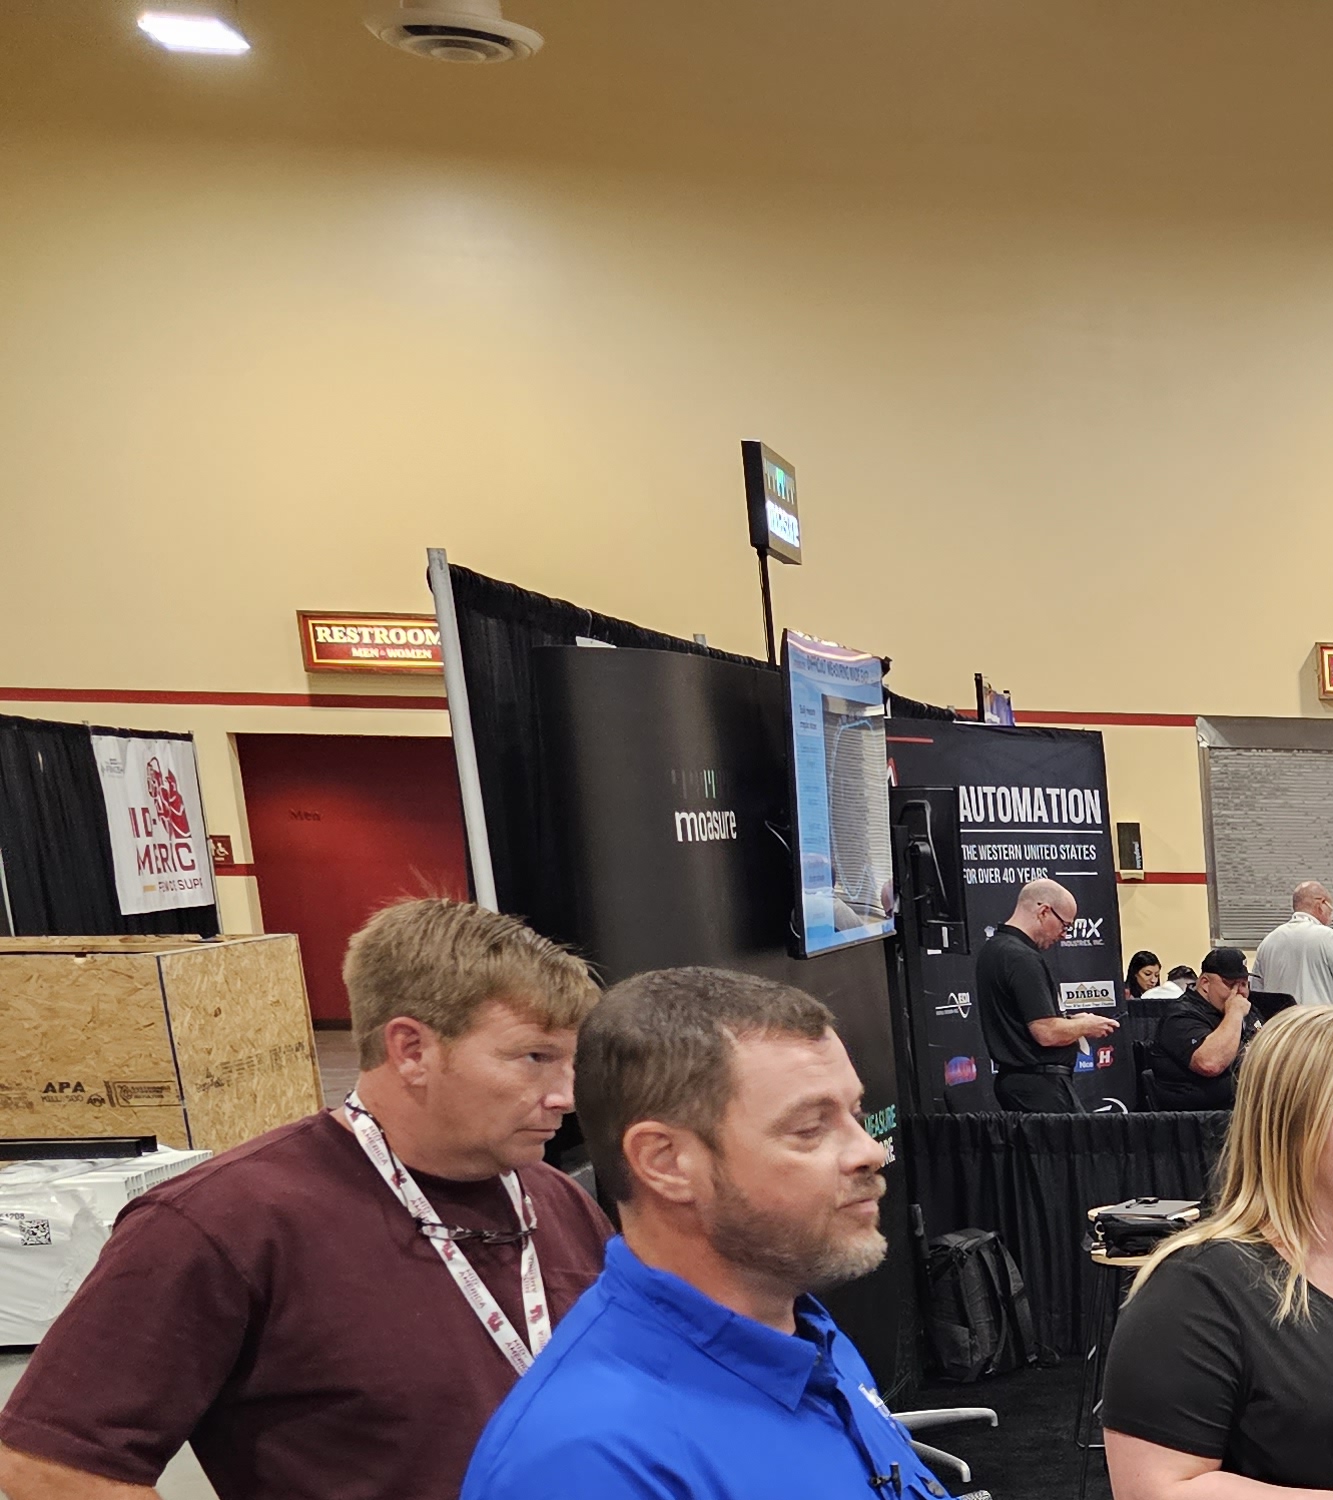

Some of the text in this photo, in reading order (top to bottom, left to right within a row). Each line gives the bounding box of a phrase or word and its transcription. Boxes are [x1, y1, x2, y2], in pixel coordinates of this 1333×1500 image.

[351, 647, 433, 659] MEN WOMEN
[959, 785, 1103, 824] AUTOMATION
[674, 810, 737, 842] moasure
[961, 844, 1097, 861] THE WESTERN UNITED STATES
[978, 868, 1001, 884] OVER
[1002, 867, 1016, 883] 40
[1066, 988, 1110, 1000] DIABLO
[42, 1081, 86, 1094] APA
[361, 1128, 388, 1165] AMERICA
[459, 1271, 486, 1308] AMERICA
